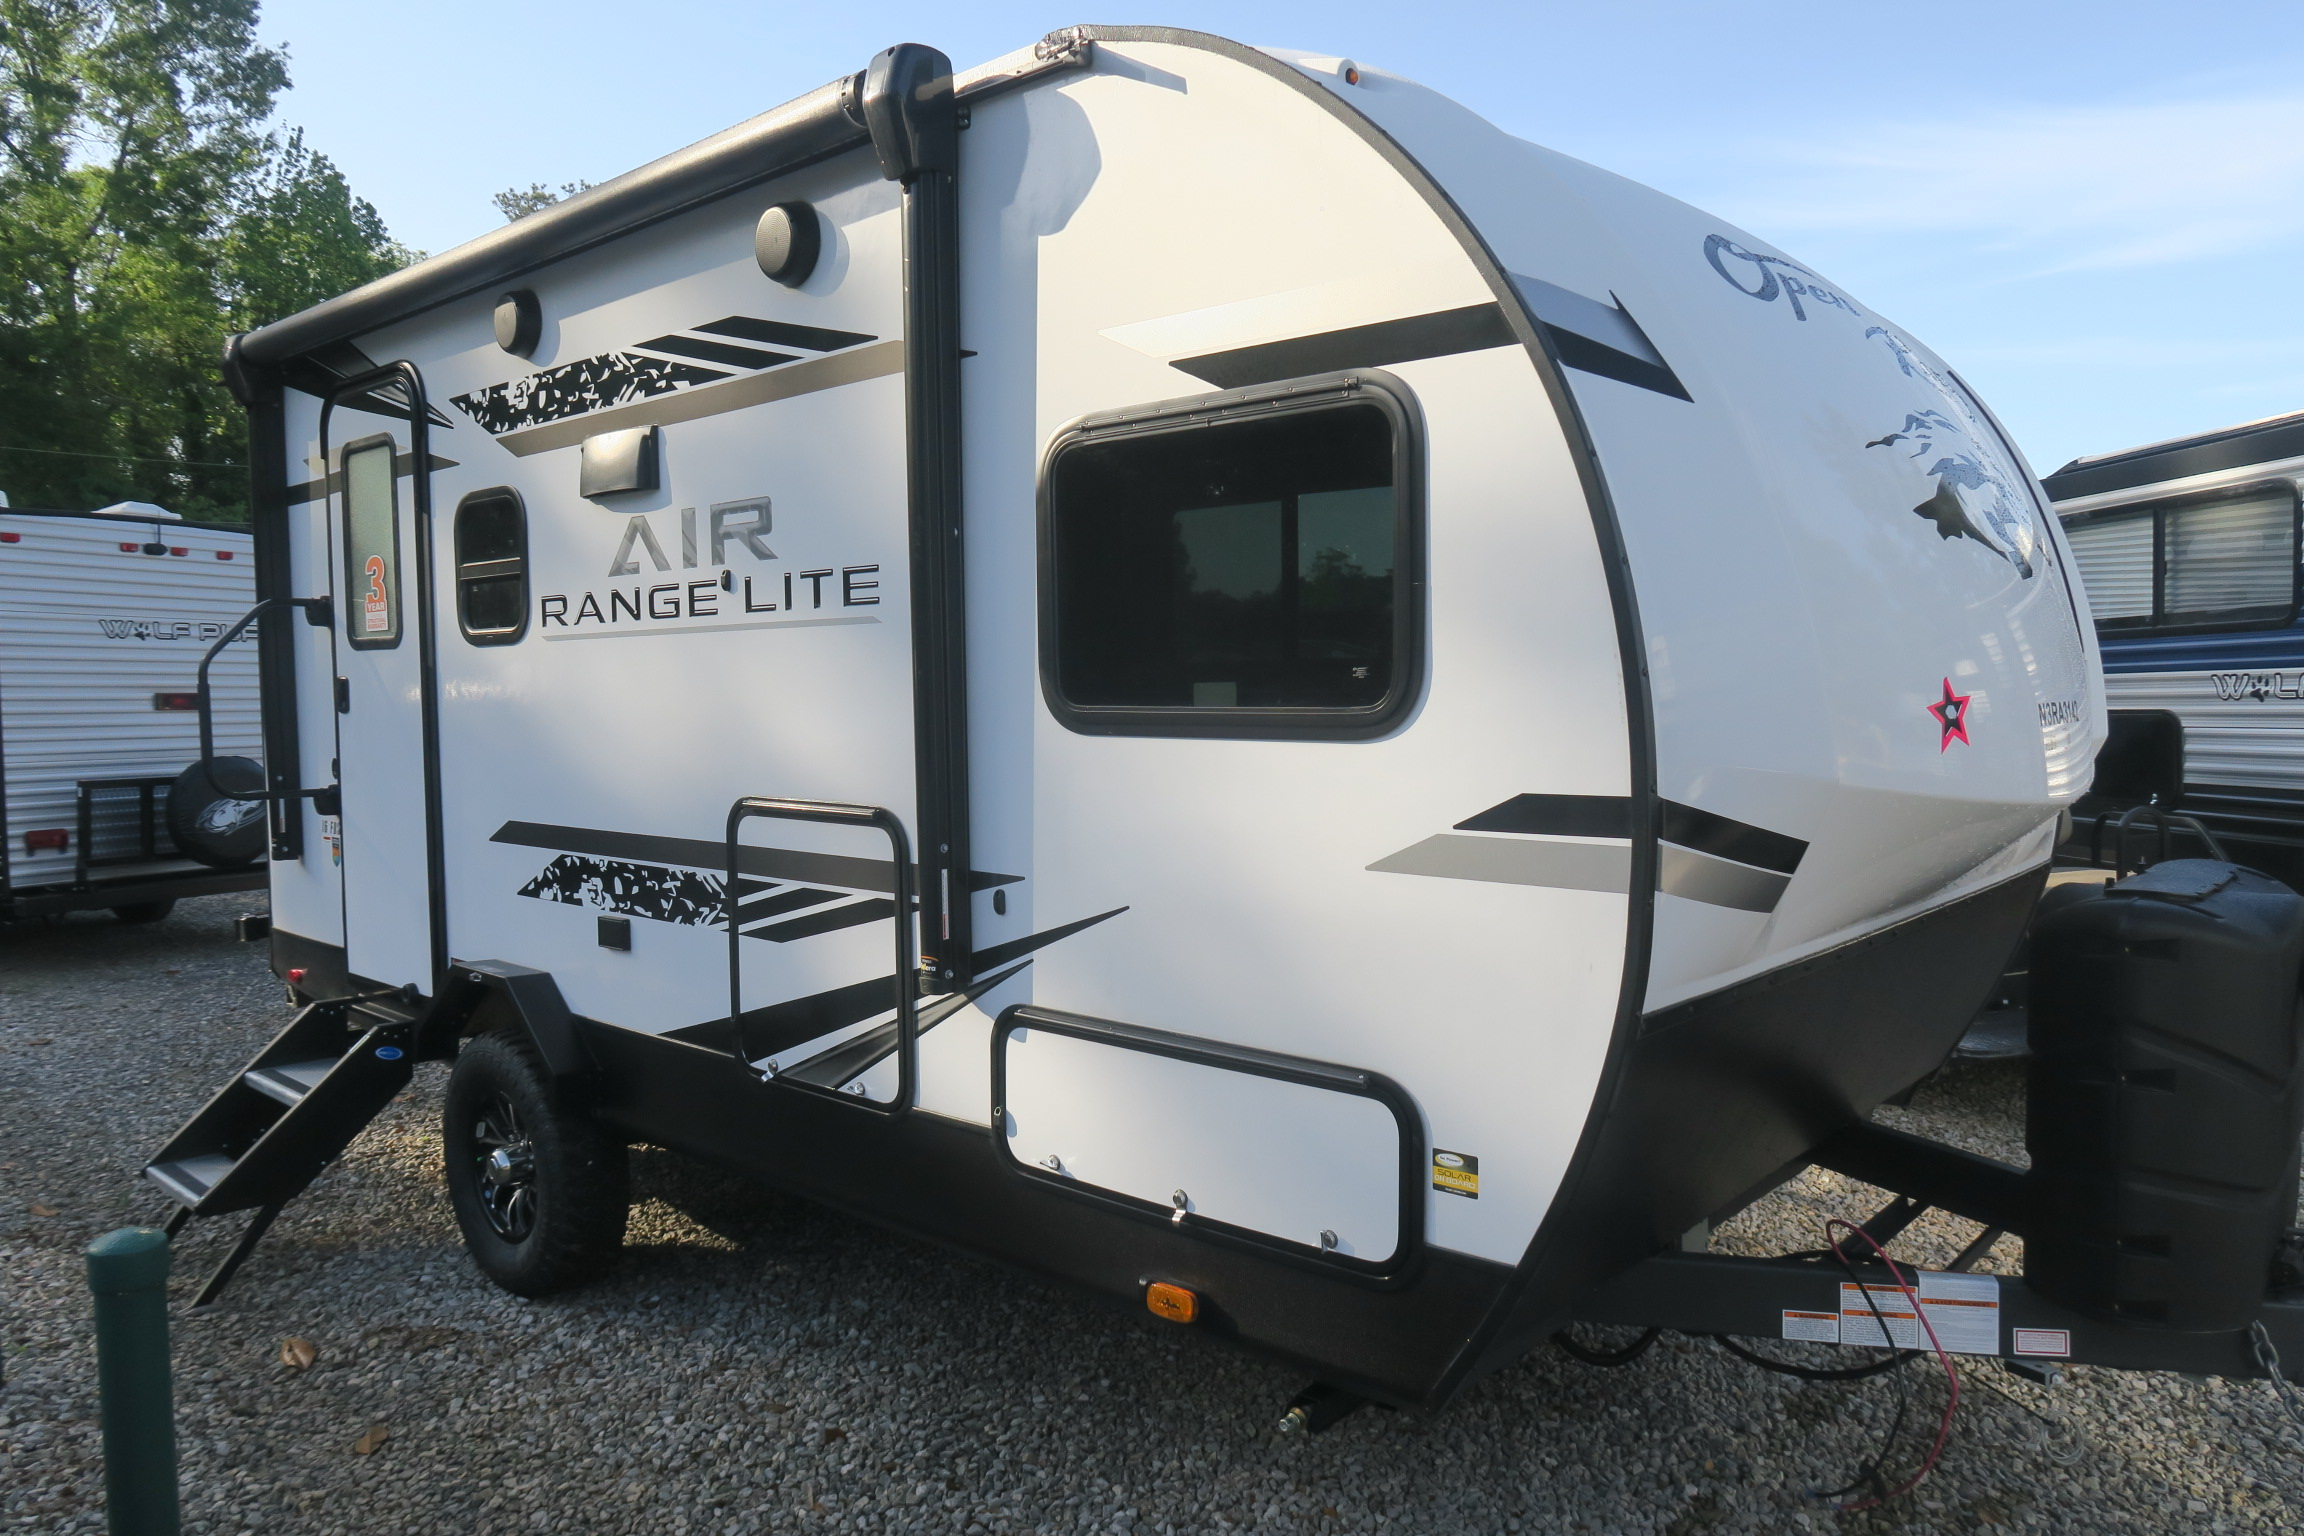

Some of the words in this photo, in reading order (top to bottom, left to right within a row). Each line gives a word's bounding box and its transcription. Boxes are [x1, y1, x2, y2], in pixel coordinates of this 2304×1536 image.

[1703, 233, 1861, 322] Open
[608, 496, 779, 578] AIR
[365, 555, 386, 602] 3
[541, 579, 719, 628] RANGE
[744, 564, 881, 614] LITE
[367, 601, 385, 612] YEAR
[2211, 672, 2304, 702] WOL
[1434, 1174, 1445, 1182] ON
[1437, 1168, 1471, 1181] SOLAR
